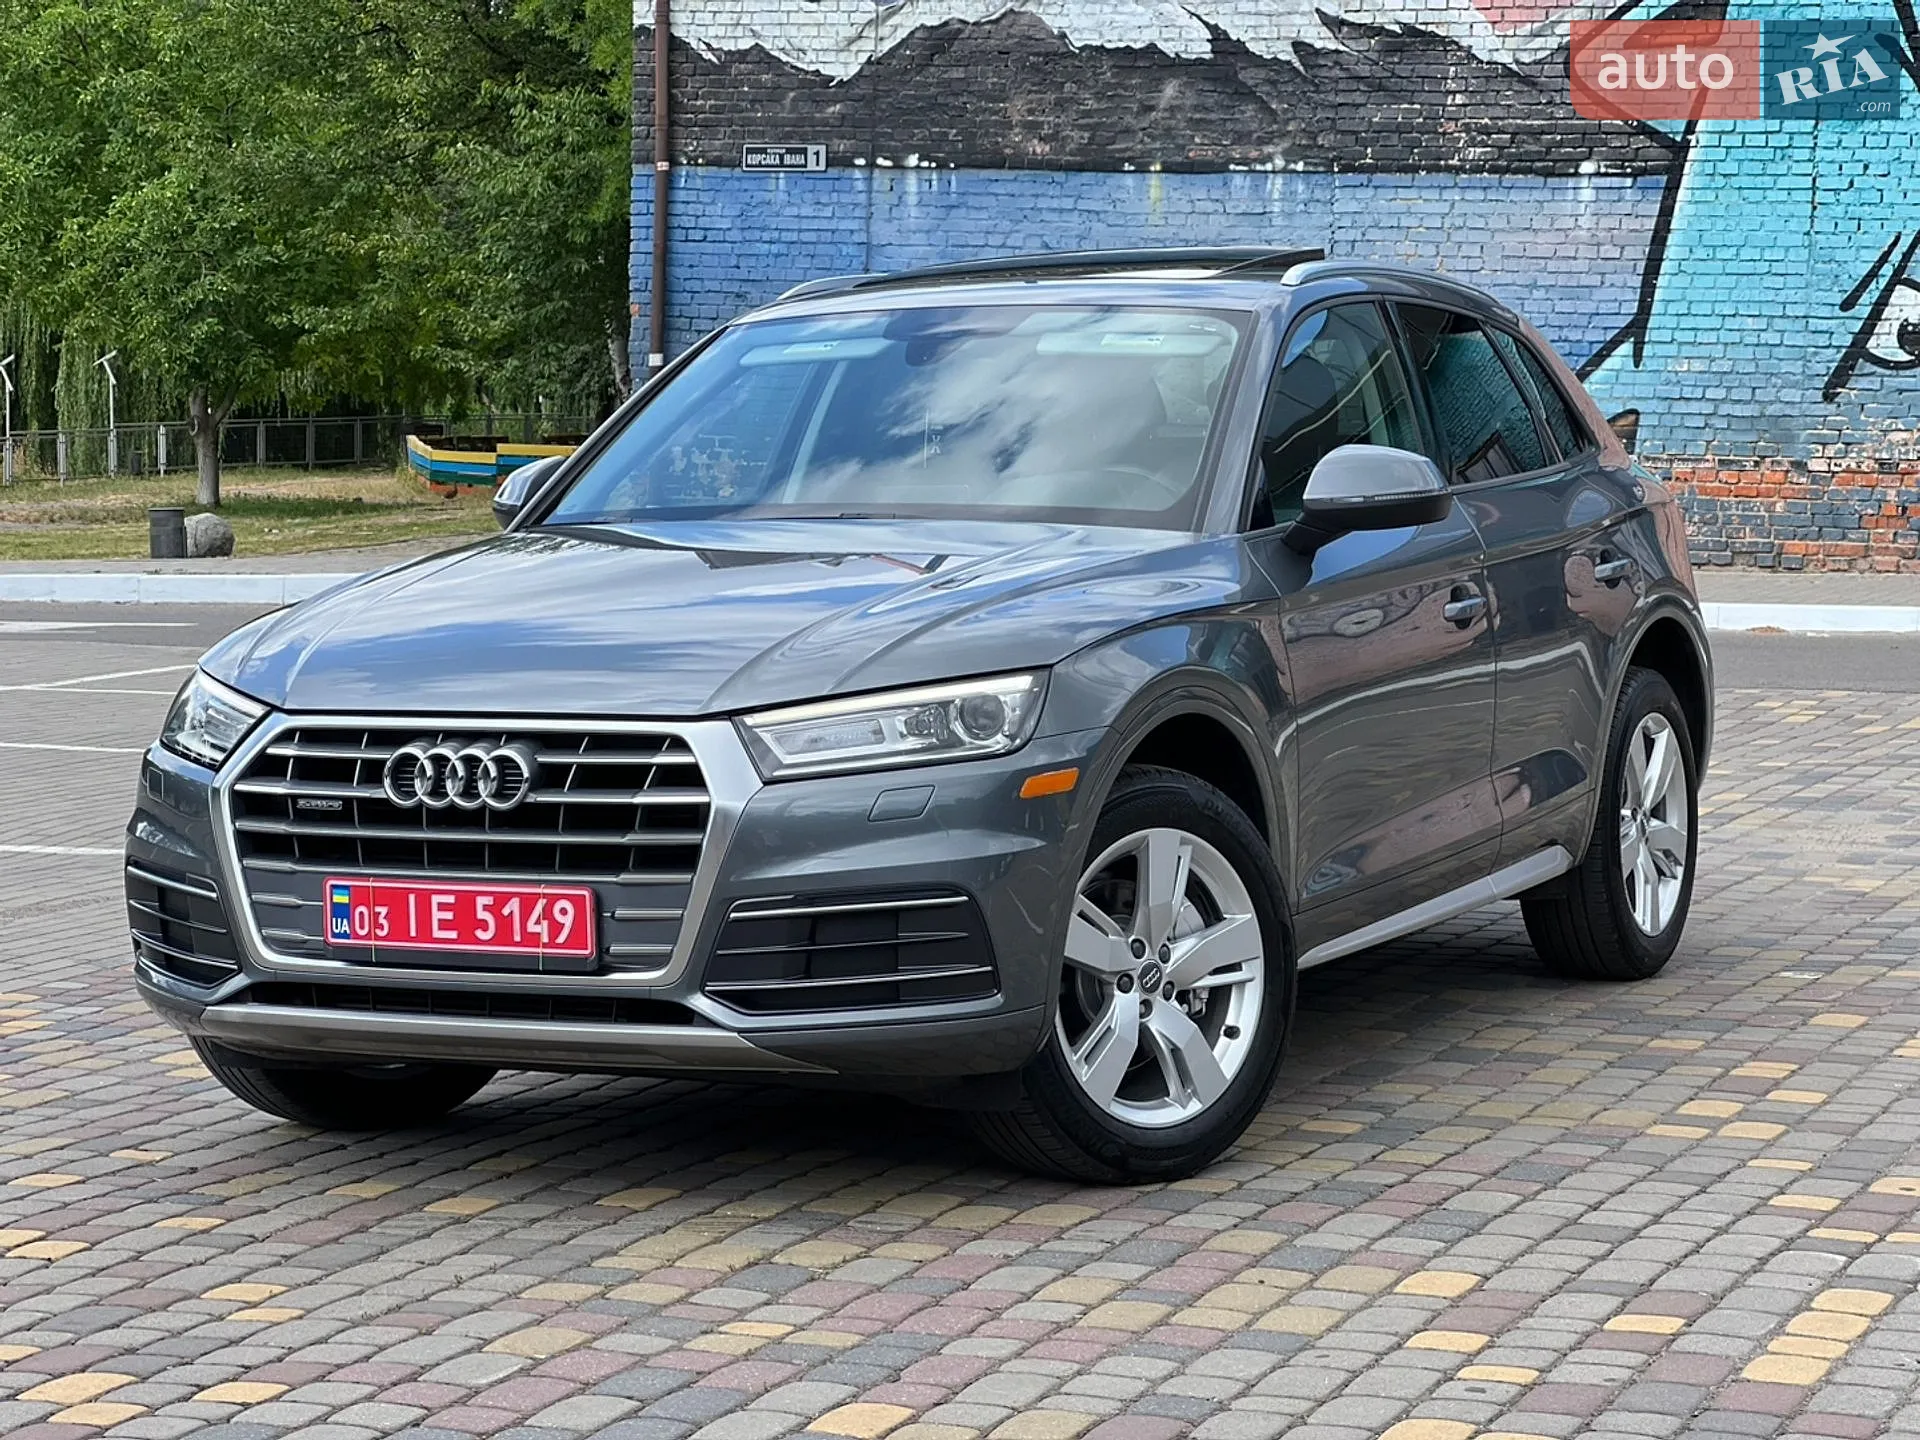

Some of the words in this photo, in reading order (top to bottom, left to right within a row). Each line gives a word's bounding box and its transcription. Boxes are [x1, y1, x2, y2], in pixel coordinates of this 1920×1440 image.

[813, 149, 820, 167] 1
[332, 917, 350, 934] UA
[354, 905, 390, 938] 03
[474, 895, 576, 944] 5149
